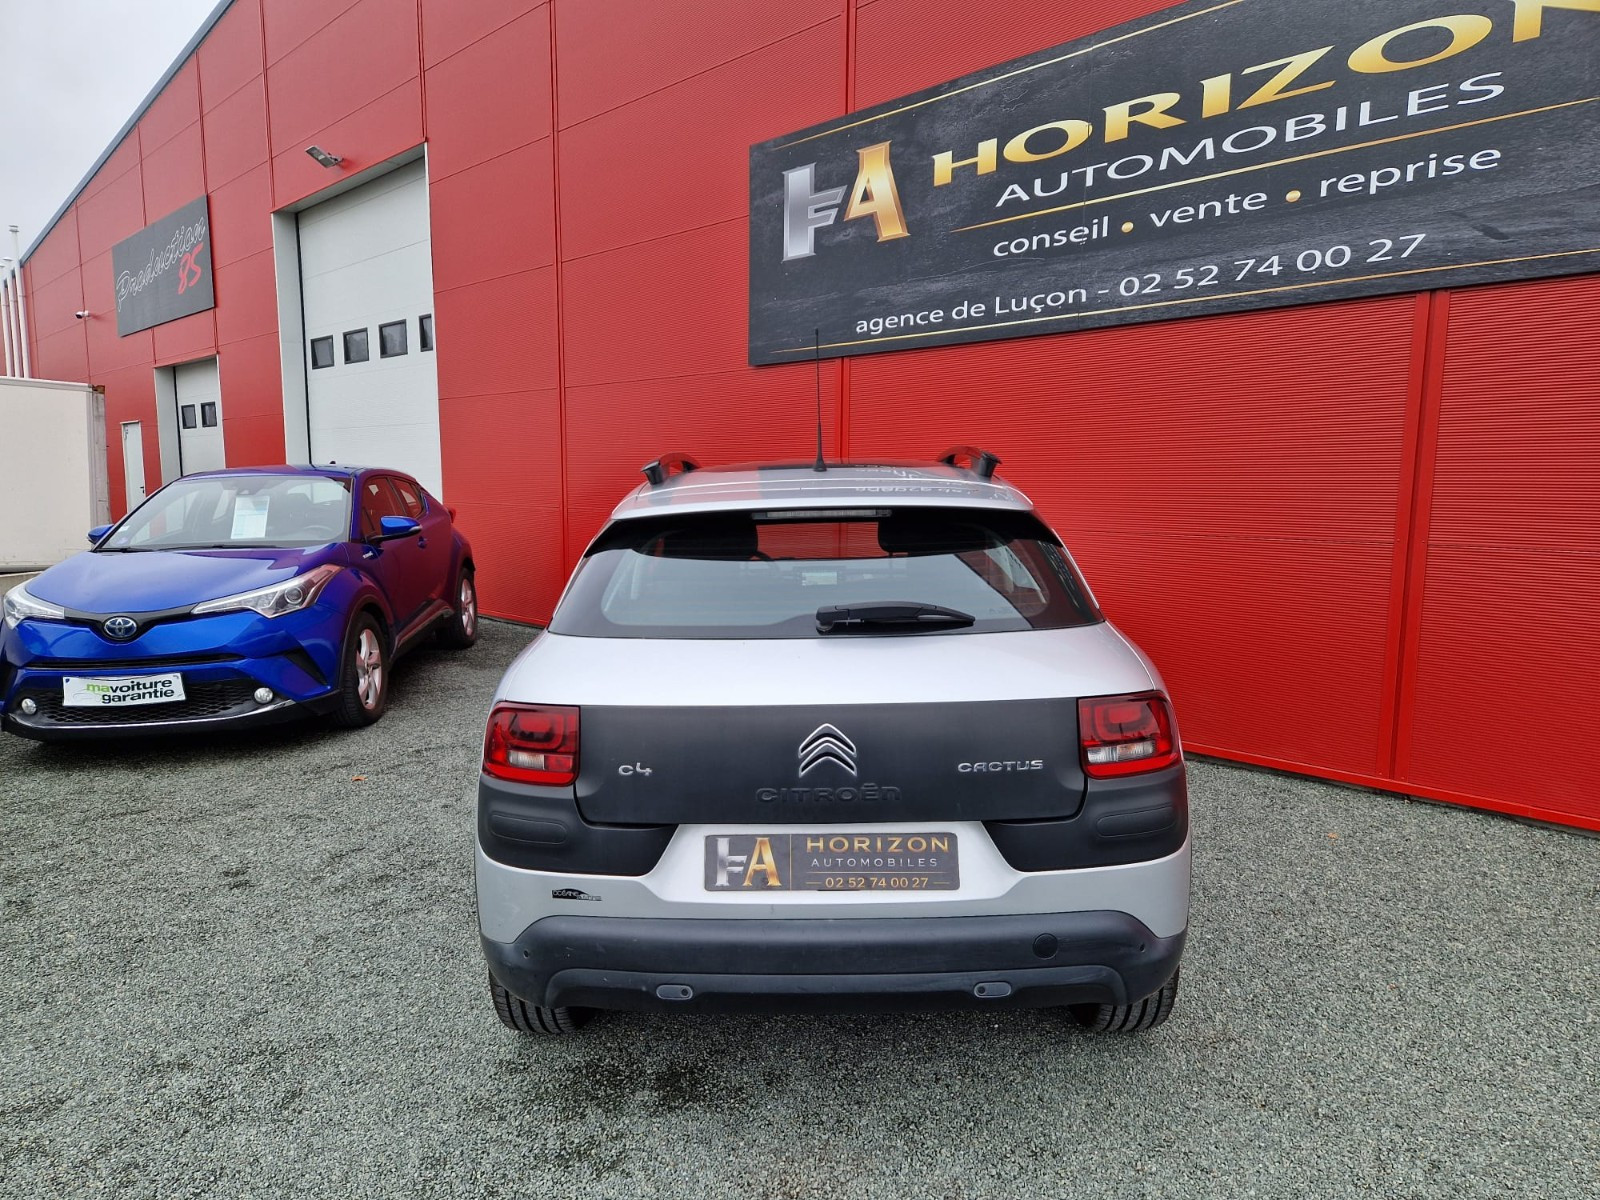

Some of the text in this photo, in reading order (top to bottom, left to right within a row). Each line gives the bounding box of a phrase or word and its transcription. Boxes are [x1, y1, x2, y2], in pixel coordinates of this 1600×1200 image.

[995, 72, 1505, 207] AUTOMOBILES
[993, 149, 1502, 257] conseil vente reprise
[855, 309, 944, 335] agence
[951, 301, 986, 320] de
[994, 288, 1087, 314] Luçon
[1119, 273, 1162, 296] 02
[1173, 265, 1219, 289] 52
[1234, 255, 1283, 281] 74
[1296, 245, 1352, 273] 00
[1366, 233, 1427, 263] 27
[101, 687, 175, 704] garantie
[618, 762, 653, 776] C4
[957, 759, 1044, 773] CACTUS
[806, 836, 949, 853] HORIZON
[811, 858, 938, 868] AUTOMOBILES
[825, 877, 929, 888] 02 52 74 00 27
